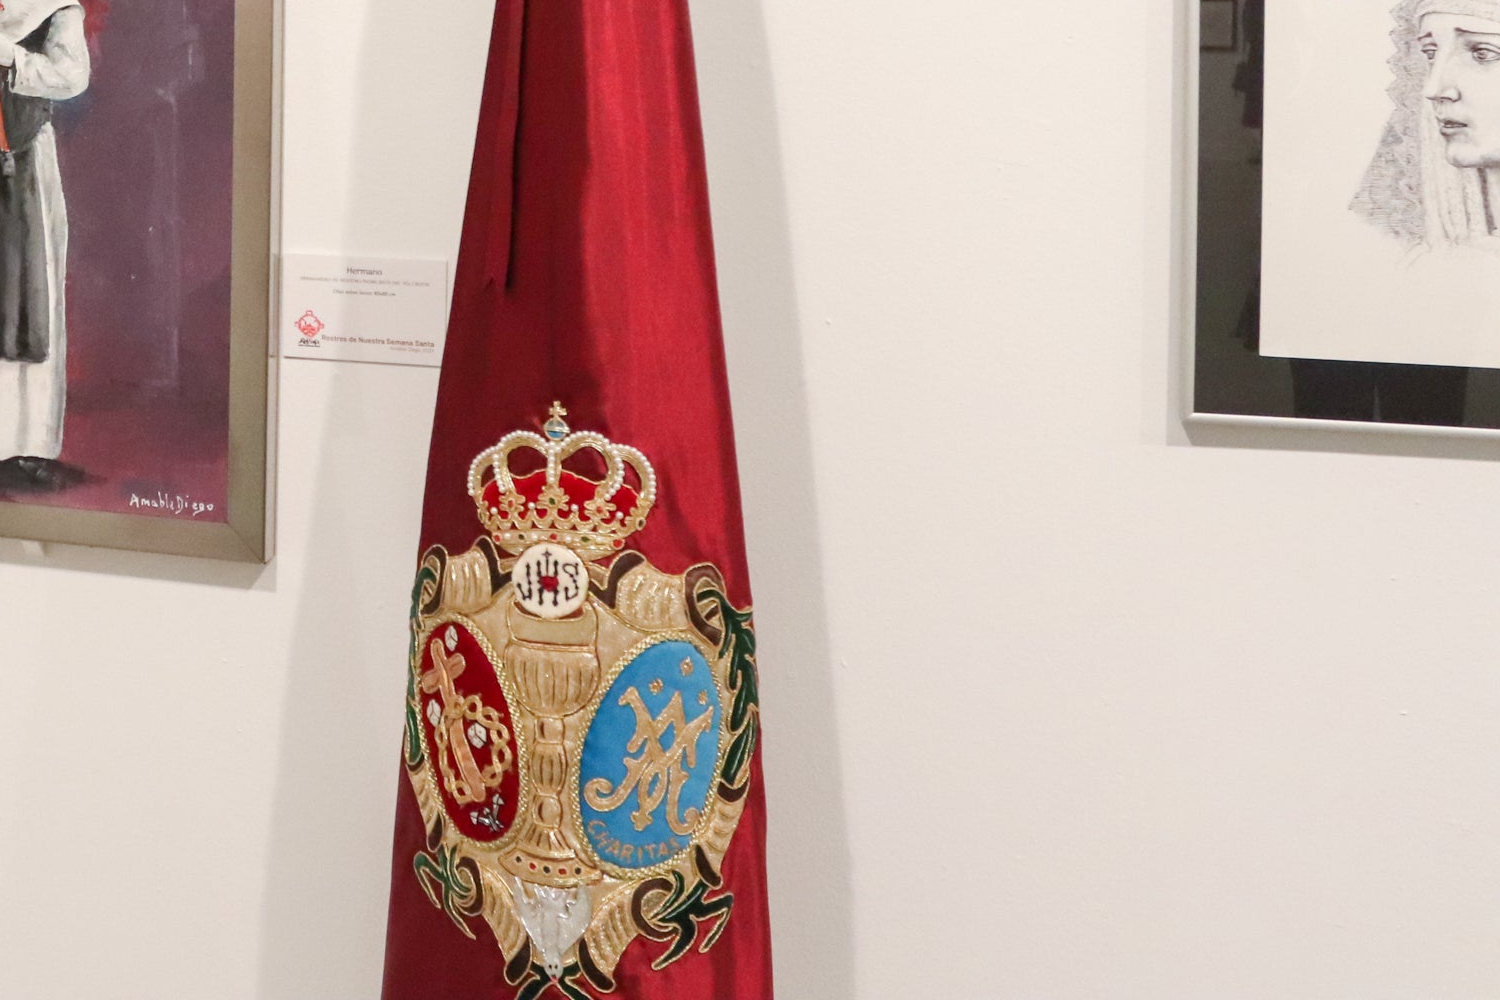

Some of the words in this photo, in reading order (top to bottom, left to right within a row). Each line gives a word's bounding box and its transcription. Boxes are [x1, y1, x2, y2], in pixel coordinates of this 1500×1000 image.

[346, 266, 383, 276] Hermano
[358, 336, 385, 345] Nuestra
[386, 338, 414, 347] Semana
[414, 339, 435, 348] Santa
